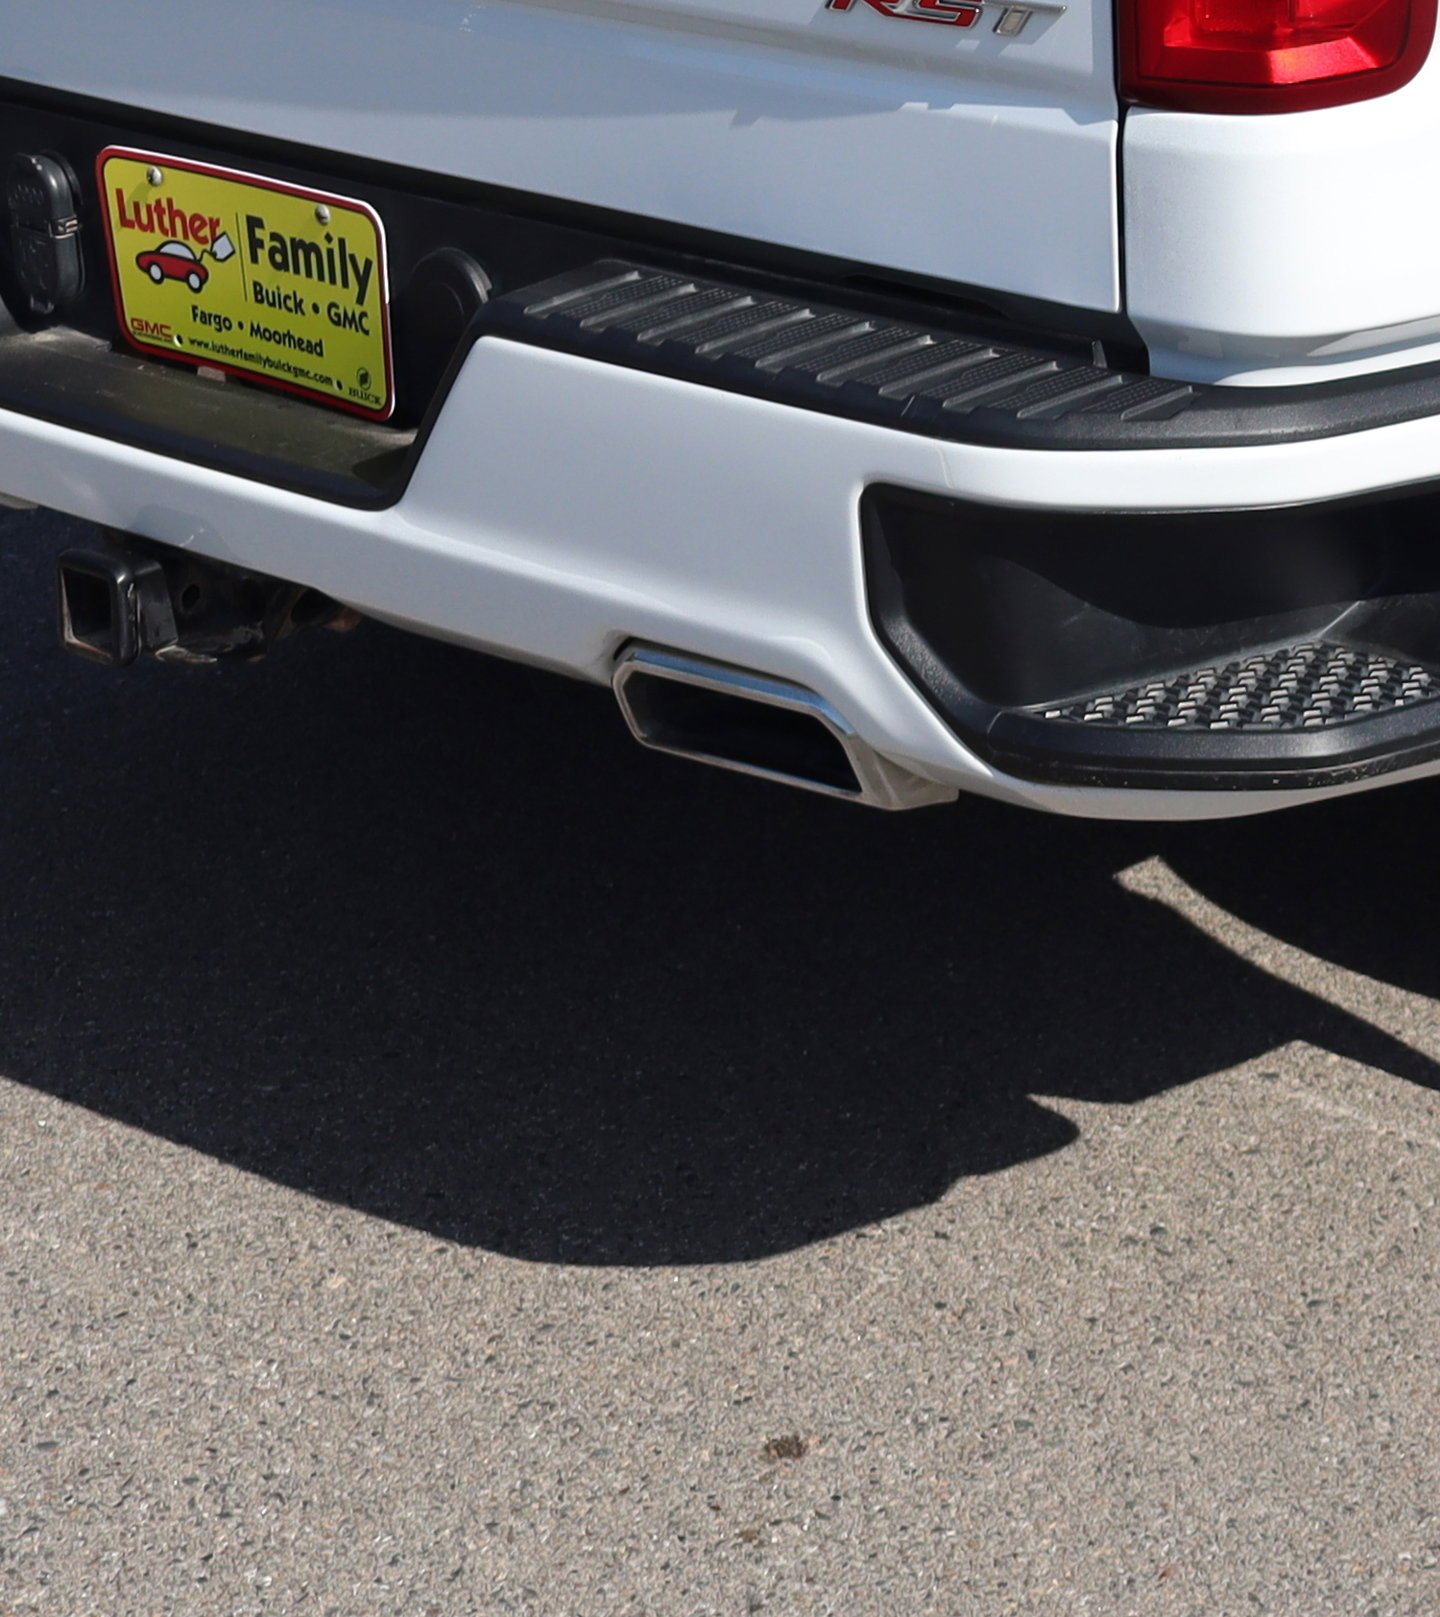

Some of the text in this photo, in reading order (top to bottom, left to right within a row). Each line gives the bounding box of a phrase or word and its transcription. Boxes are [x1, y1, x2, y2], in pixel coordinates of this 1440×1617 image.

[115, 187, 373, 306] Luther Family
[131, 318, 173, 339] GMC
[191, 304, 324, 358] Fargo Moorhead
[252, 281, 371, 336] Buick GMC
[188, 336, 333, 386] www.lutherfamilybuickgmc.com
[348, 387, 382, 406] BUICK
